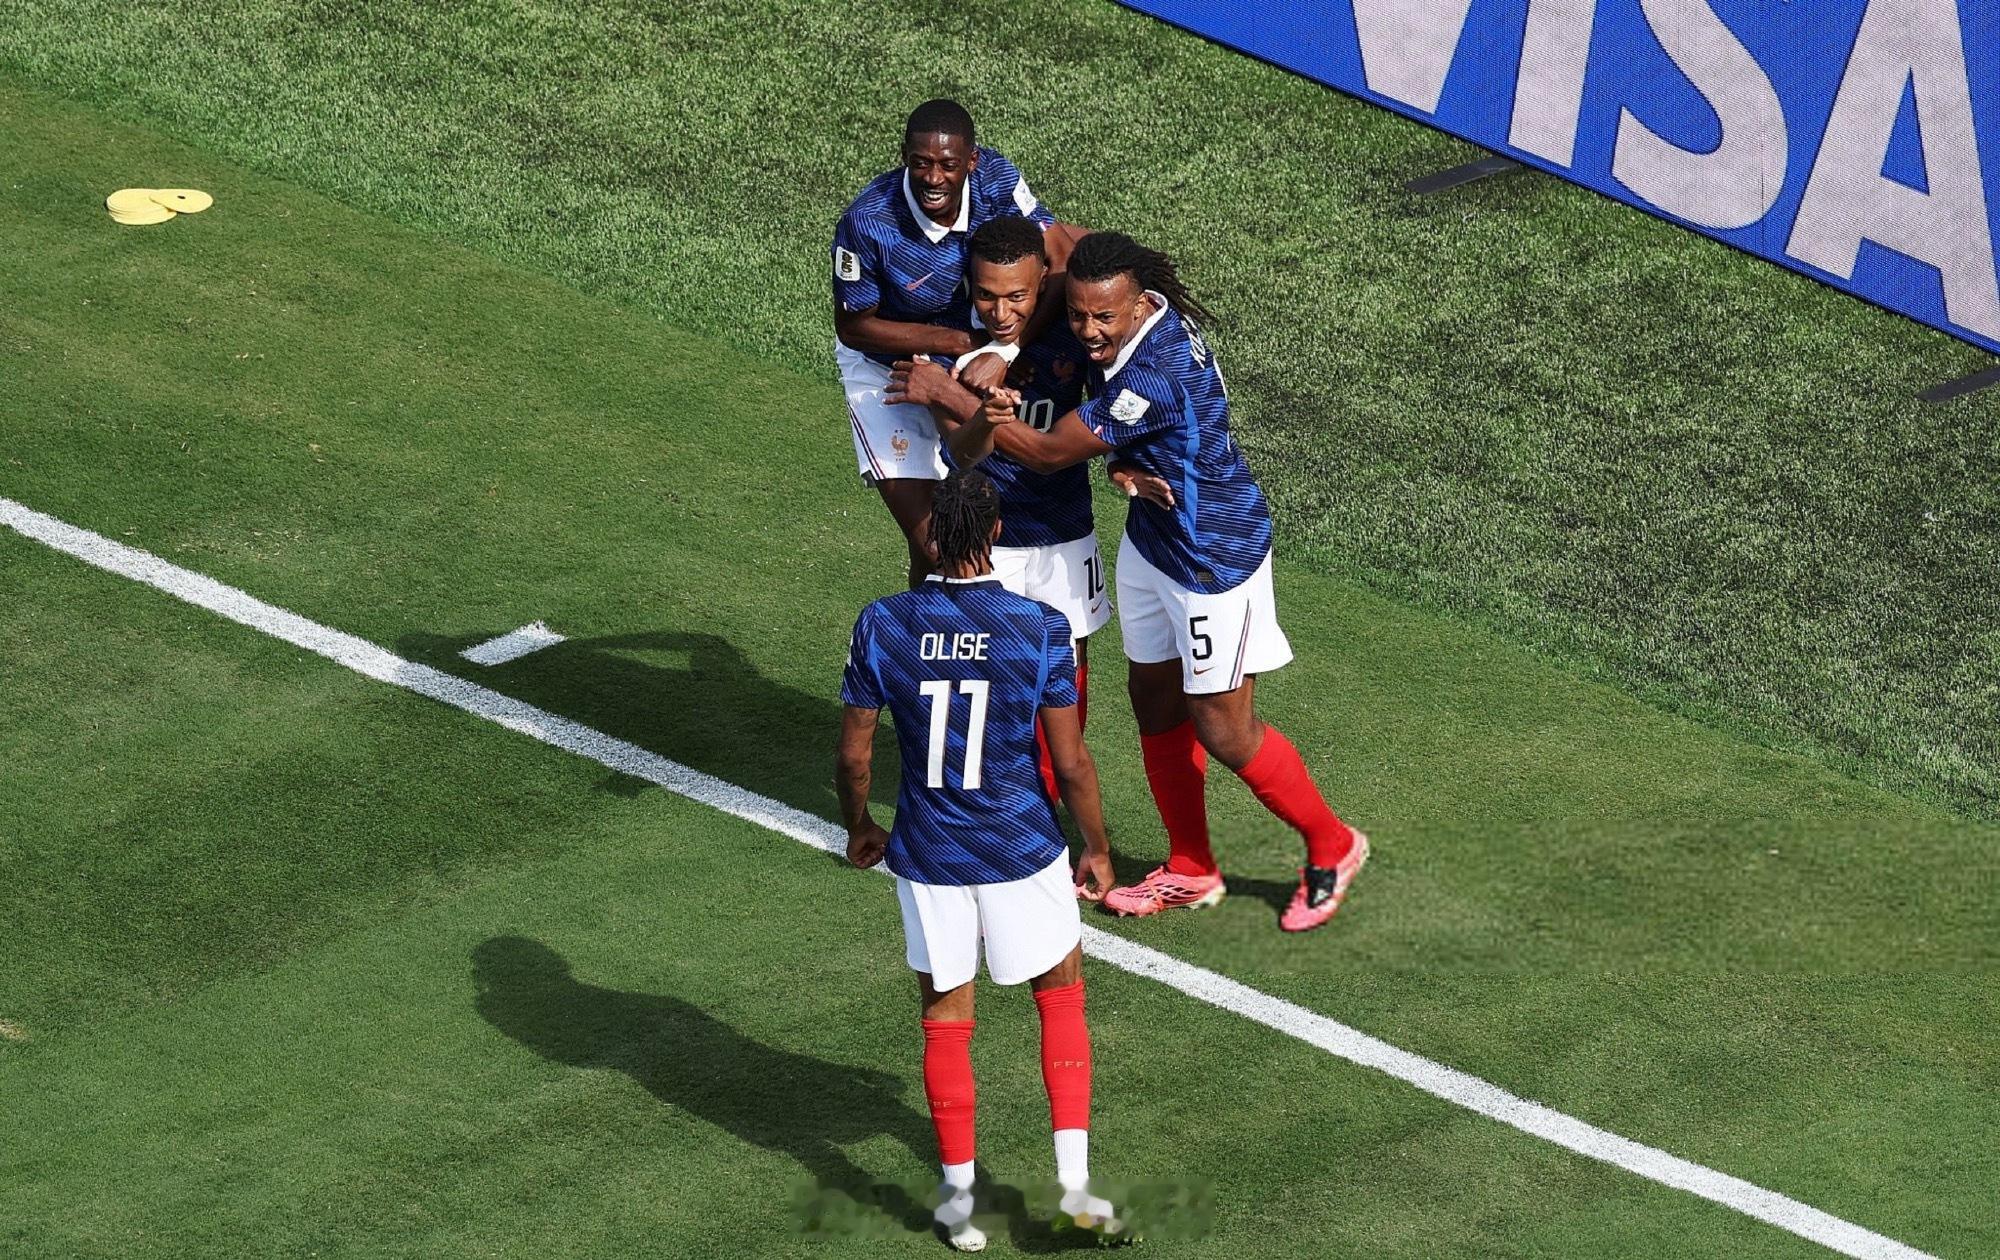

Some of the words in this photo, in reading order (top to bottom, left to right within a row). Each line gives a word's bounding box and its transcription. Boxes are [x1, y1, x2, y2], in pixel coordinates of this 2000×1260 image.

[1084, 546, 1105, 600] 10
[919, 632, 991, 661] OLISE
[1189, 615, 1213, 660] 5
[919, 679, 991, 790] 11
[1053, 1061, 1085, 1069] FFF
